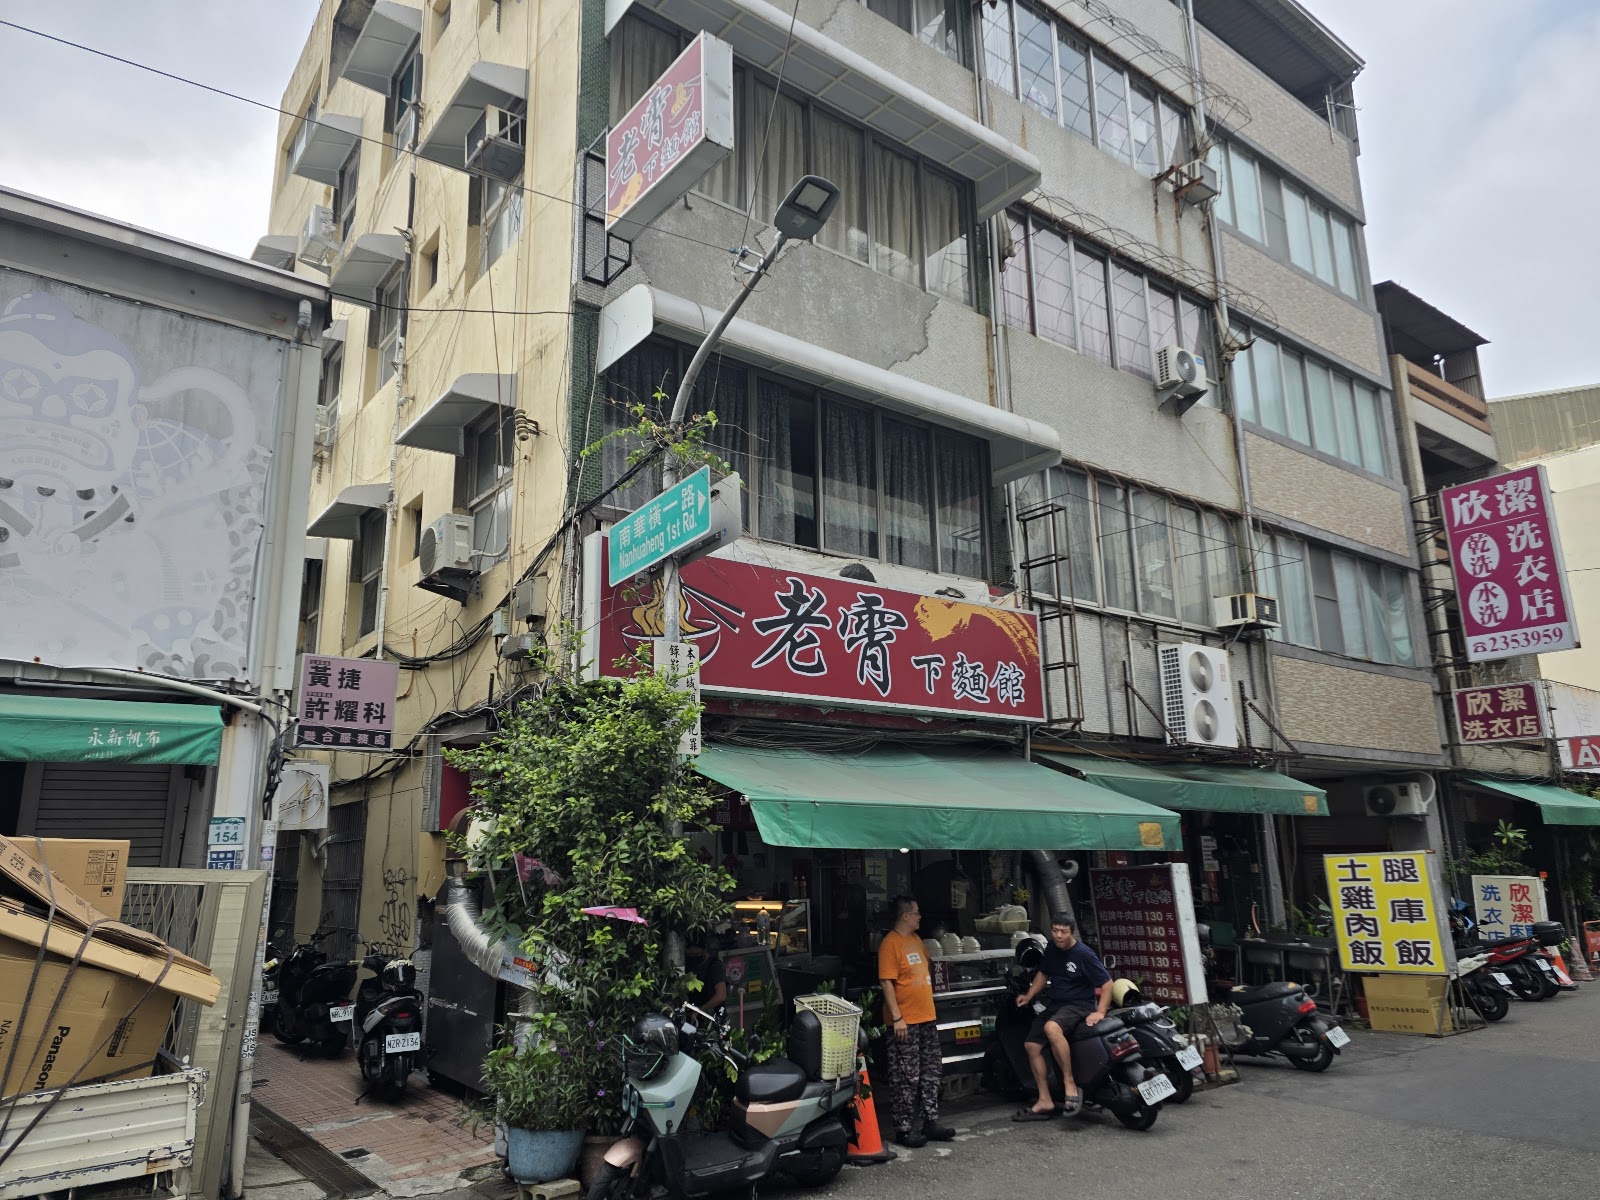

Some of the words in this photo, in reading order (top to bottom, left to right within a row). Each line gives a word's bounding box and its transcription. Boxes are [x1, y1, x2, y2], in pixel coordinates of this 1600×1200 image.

[1451, 476, 1538, 528] 欣潔
[618, 484, 695, 550] 南華橫一路
[619, 530, 664, 571] Nanhuaheng
[666, 519, 681, 542] 1st
[682, 508, 697, 533] Rd.
[1467, 534, 1493, 577] 乾洗
[1507, 521, 1556, 622] 洗衣店
[1476, 582, 1503, 626] 水洗
[1488, 626, 1564, 653] 2353959
[308, 665, 362, 691] 黃捷
[911, 653, 1026, 708] 下麵館
[305, 698, 387, 725] 許耀科
[1466, 688, 1528, 716] 欣潔
[87, 727, 161, 748] 永新帆布
[303, 730, 386, 746] 聯合服務處
[1463, 715, 1538, 741] 洗衣店
[215, 832, 238, 843] 154
[212, 862, 231, 870] 154
[1144, 911, 1163, 922] 130
[1165, 912, 1174, 921] 元
[1337, 858, 1385, 966] 土雞肉飯
[1382, 857, 1435, 966] 腿庫飯
[1480, 884, 1506, 940] 洗衣店
[1509, 883, 1535, 924] 欣潔
[1146, 926, 1165, 937] 140
[1168, 927, 1176, 936] 元
[1148, 941, 1167, 952] 130
[1170, 943, 1178, 952] 元
[934, 962, 944, 984] 水餃
[1151, 957, 1170, 968] 130
[1172, 959, 1181, 968] 元
[1155, 973, 1169, 983] 55
[1174, 974, 1183, 984] 元
[1155, 988, 1169, 998] 40
